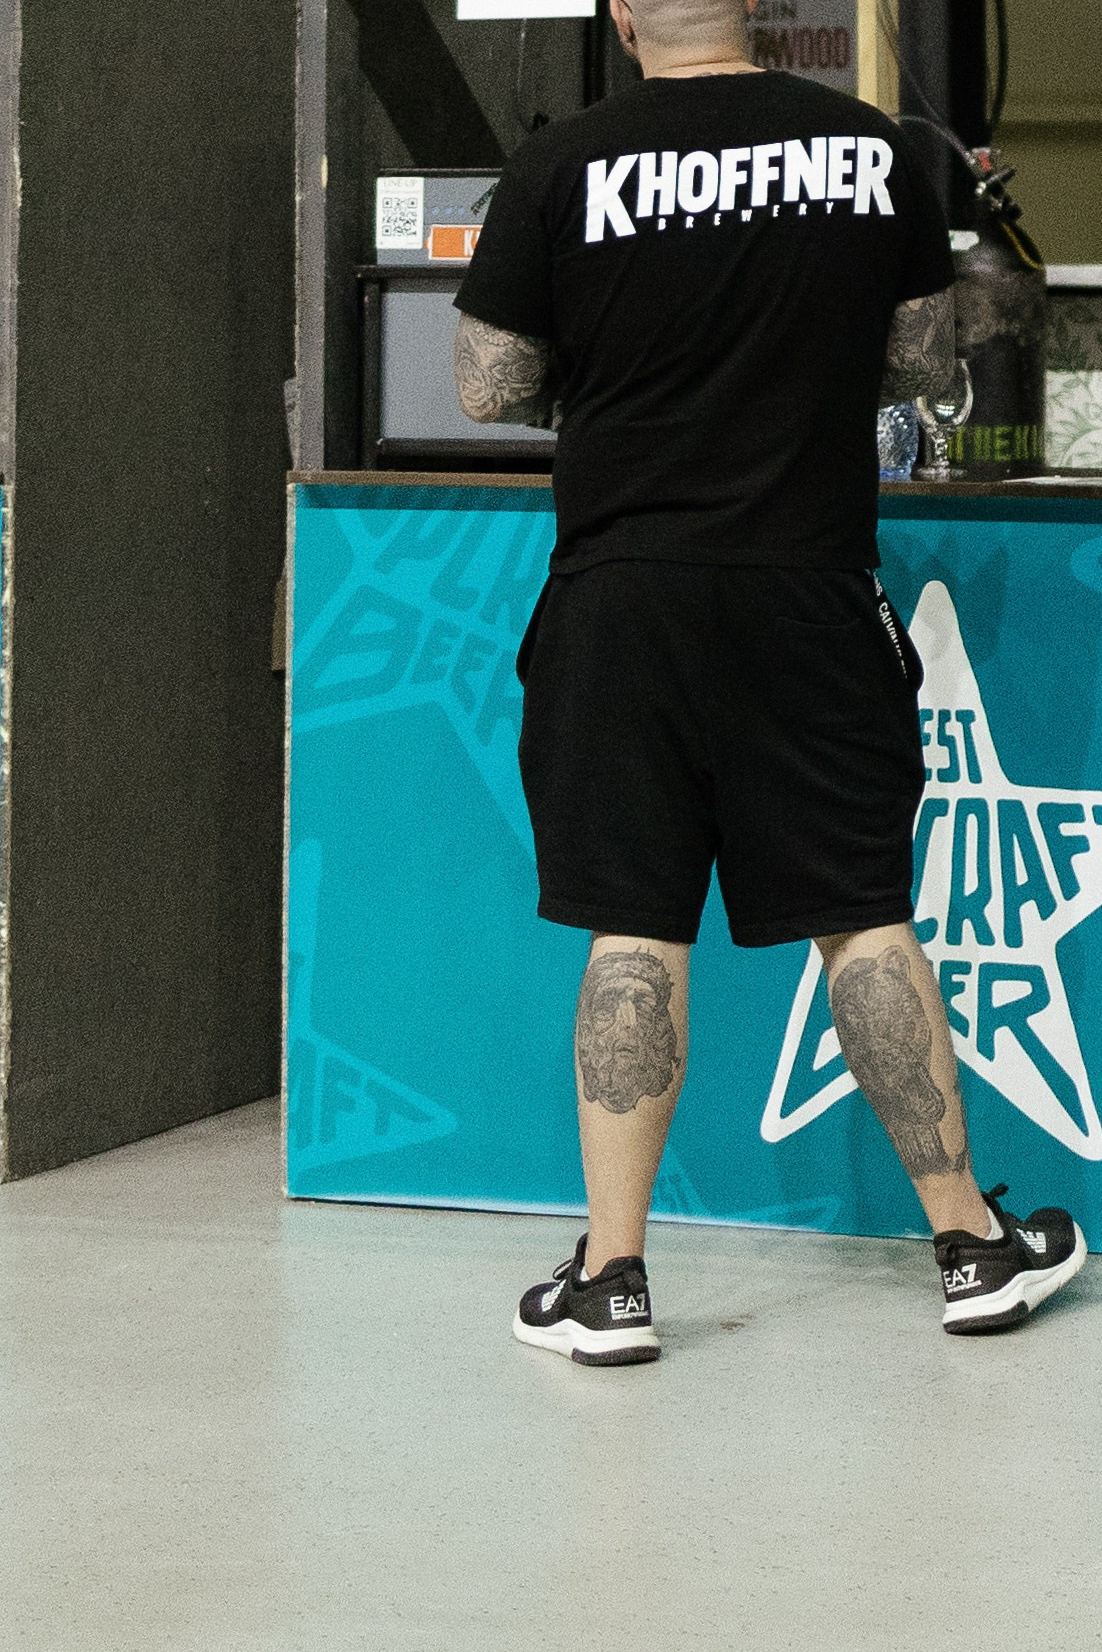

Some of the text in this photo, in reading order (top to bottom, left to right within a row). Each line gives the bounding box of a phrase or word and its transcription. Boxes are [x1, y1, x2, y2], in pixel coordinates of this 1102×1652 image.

[585, 136, 896, 244] KHOFFNER
[657, 201, 835, 231] BREWERY
[918, 708, 984, 785] EST
[943, 1262, 978, 1289] EA7
[609, 1292, 647, 1314] EA7
